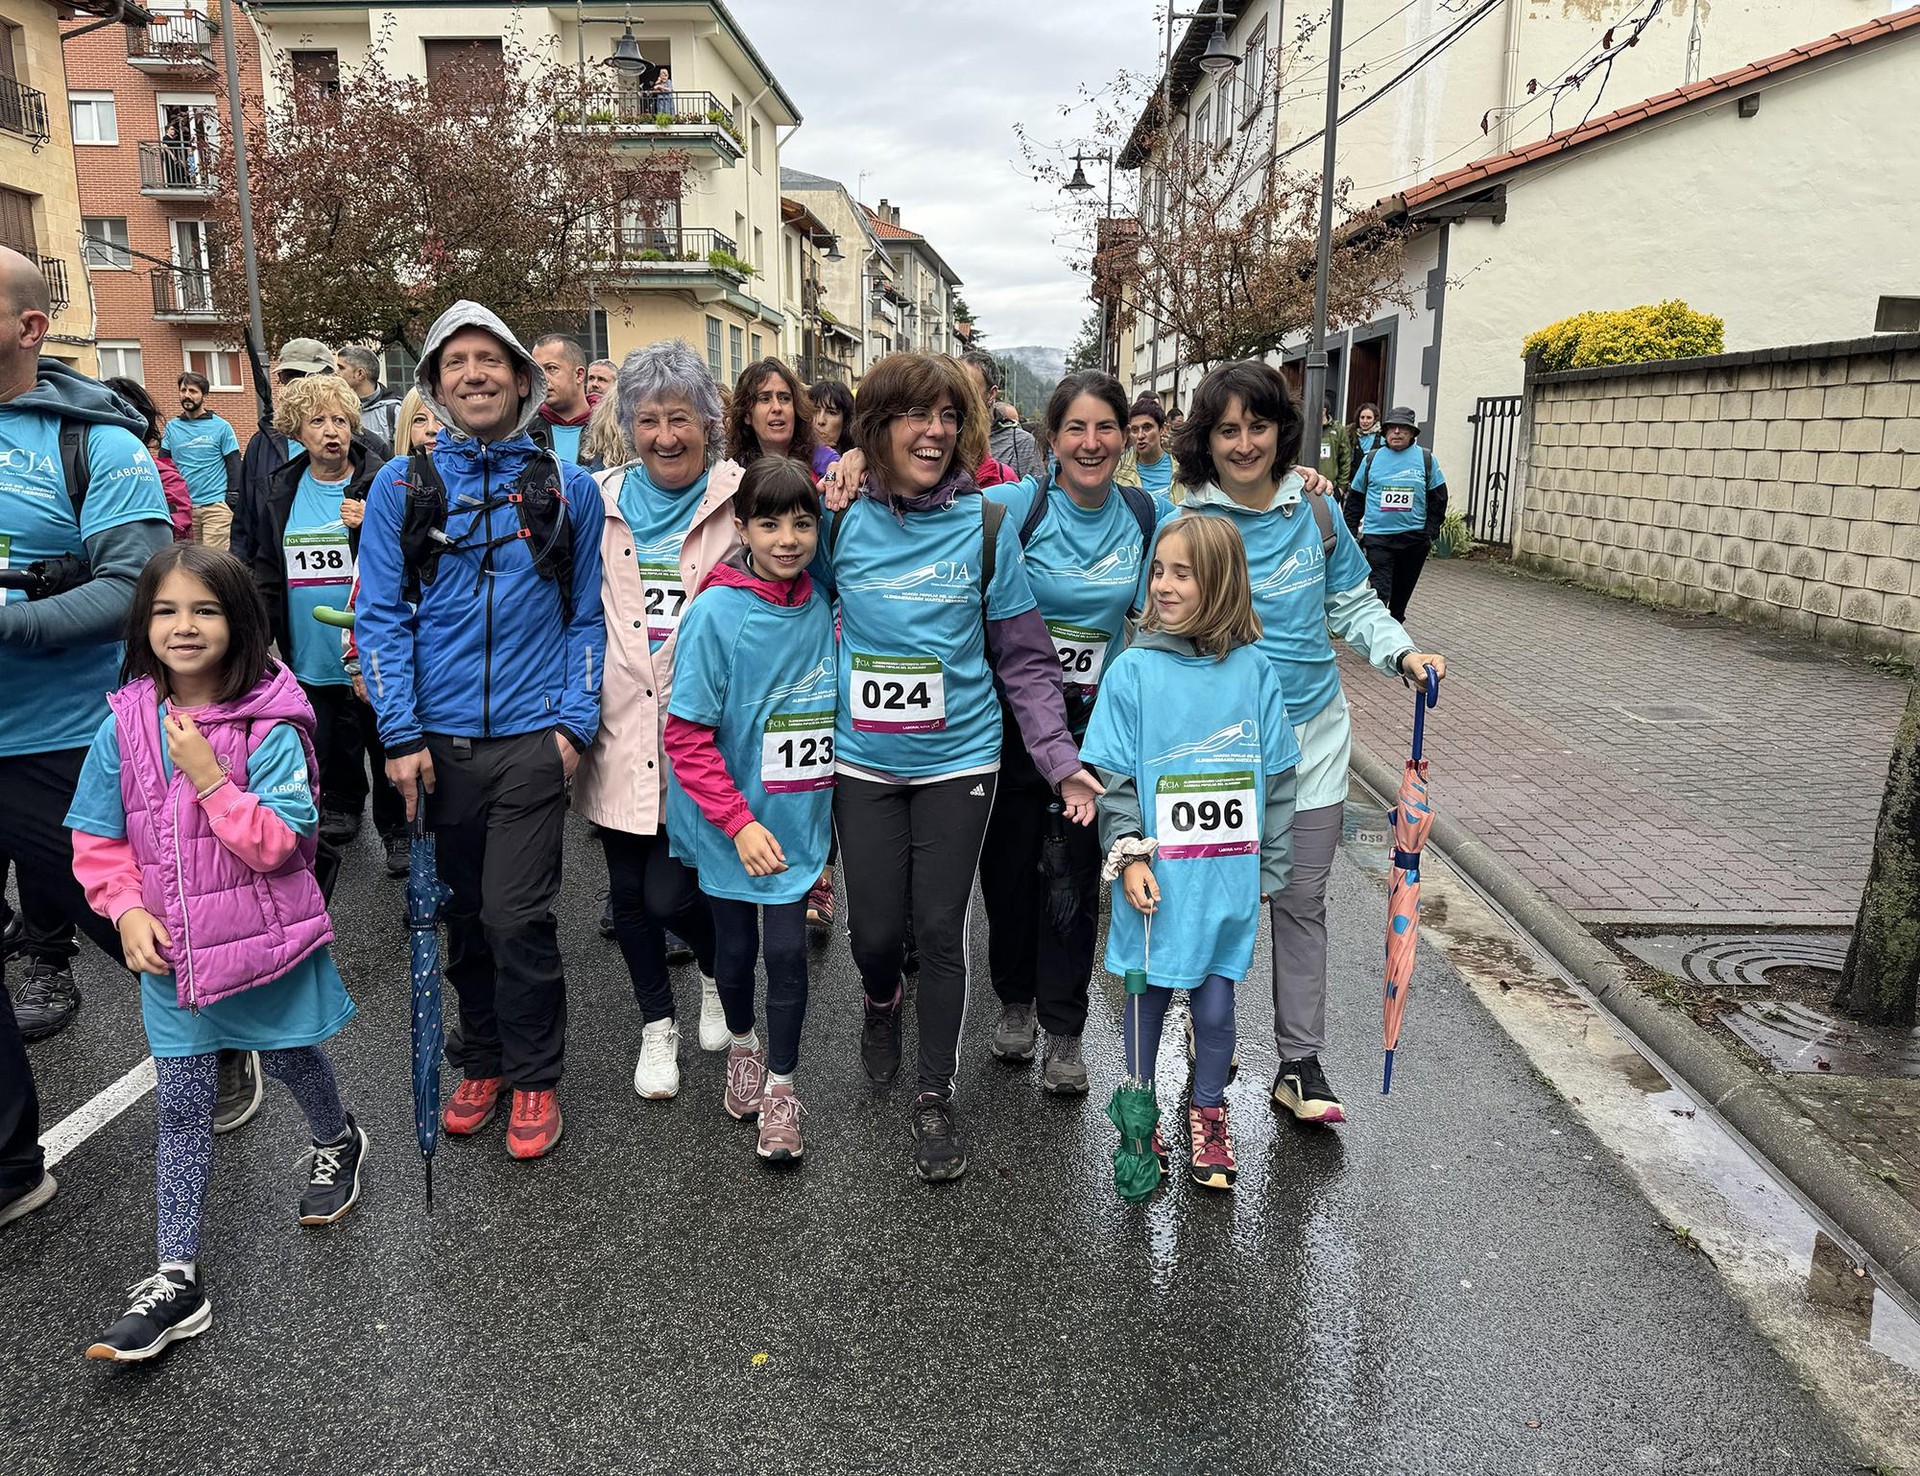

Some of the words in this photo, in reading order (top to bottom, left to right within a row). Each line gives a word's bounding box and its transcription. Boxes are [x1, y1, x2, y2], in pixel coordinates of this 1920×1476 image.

[7, 448, 58, 474] CJA
[1385, 493, 1409, 504] 028
[295, 550, 344, 570] 138
[1294, 544, 1324, 567] CJA
[933, 561, 971, 583] CJA
[862, 680, 931, 710] 024
[778, 736, 834, 768] 123
[1166, 781, 1180, 789] CJA
[1171, 798, 1243, 832] 096
